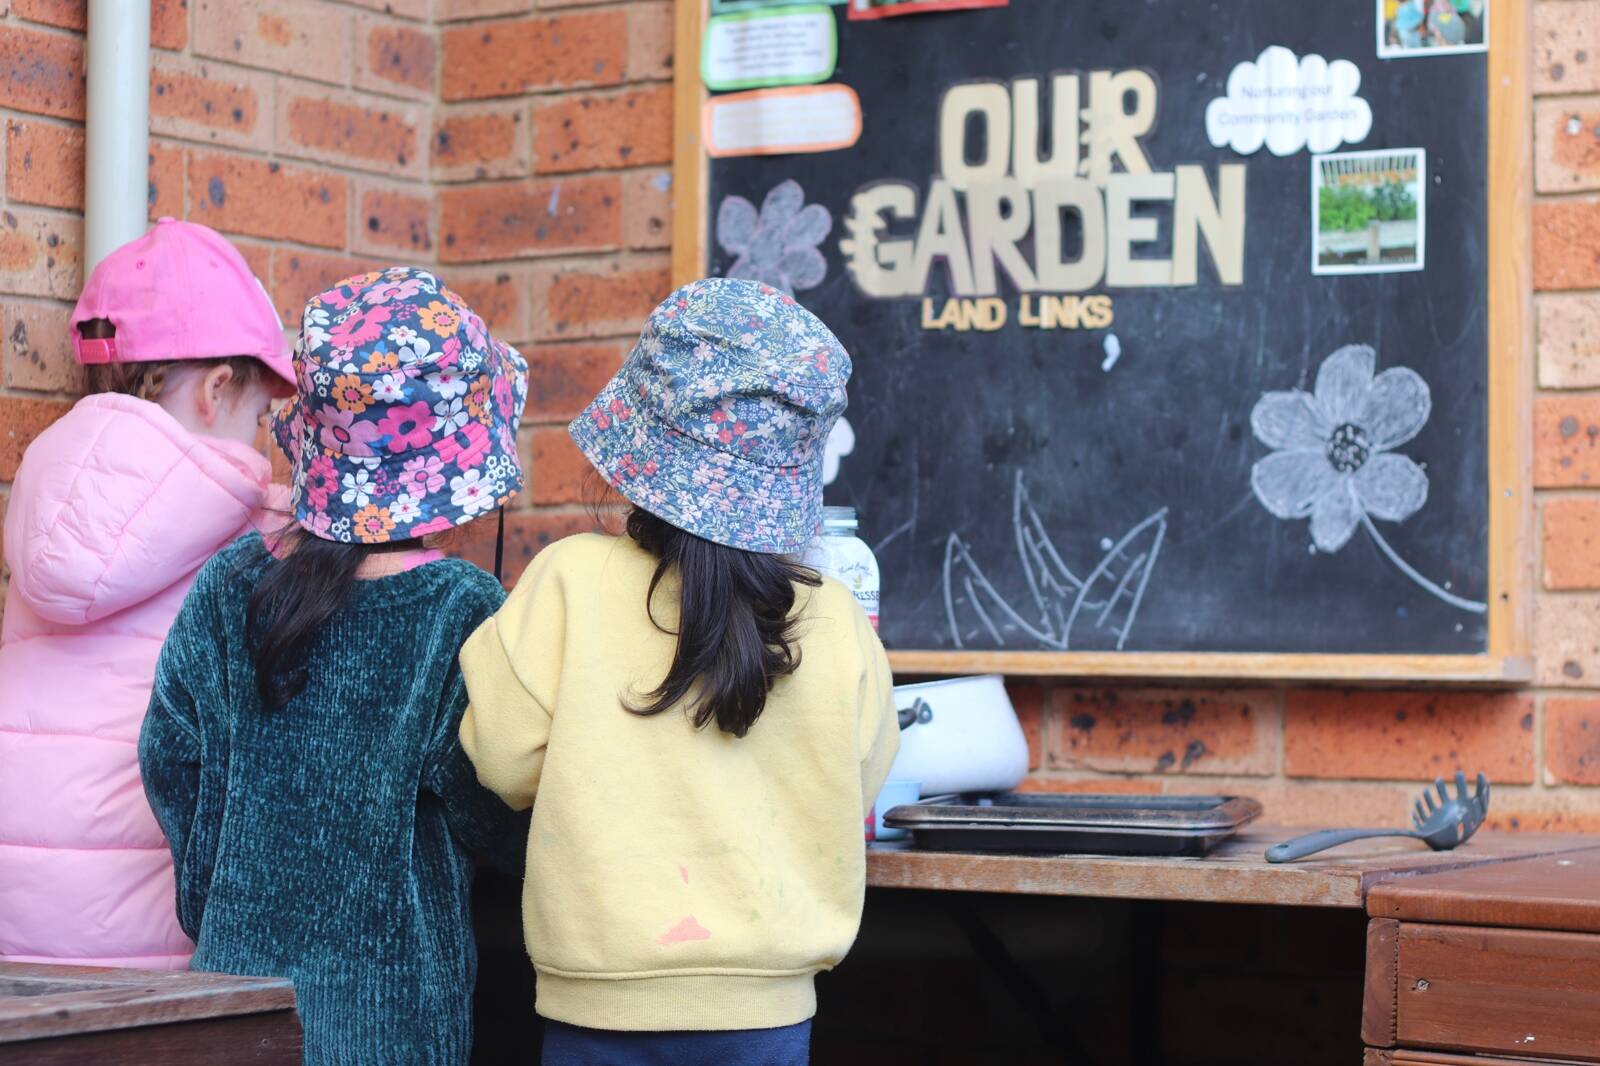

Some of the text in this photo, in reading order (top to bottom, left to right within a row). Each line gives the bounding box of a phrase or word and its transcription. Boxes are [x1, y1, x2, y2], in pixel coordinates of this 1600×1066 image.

[1242, 85, 1306, 100] Nurturing
[940, 68, 1157, 193] OUR
[1218, 107, 1358, 126] Community Garden
[838, 163, 1246, 298] GARDEN
[921, 294, 1114, 331] LAND LINKS
